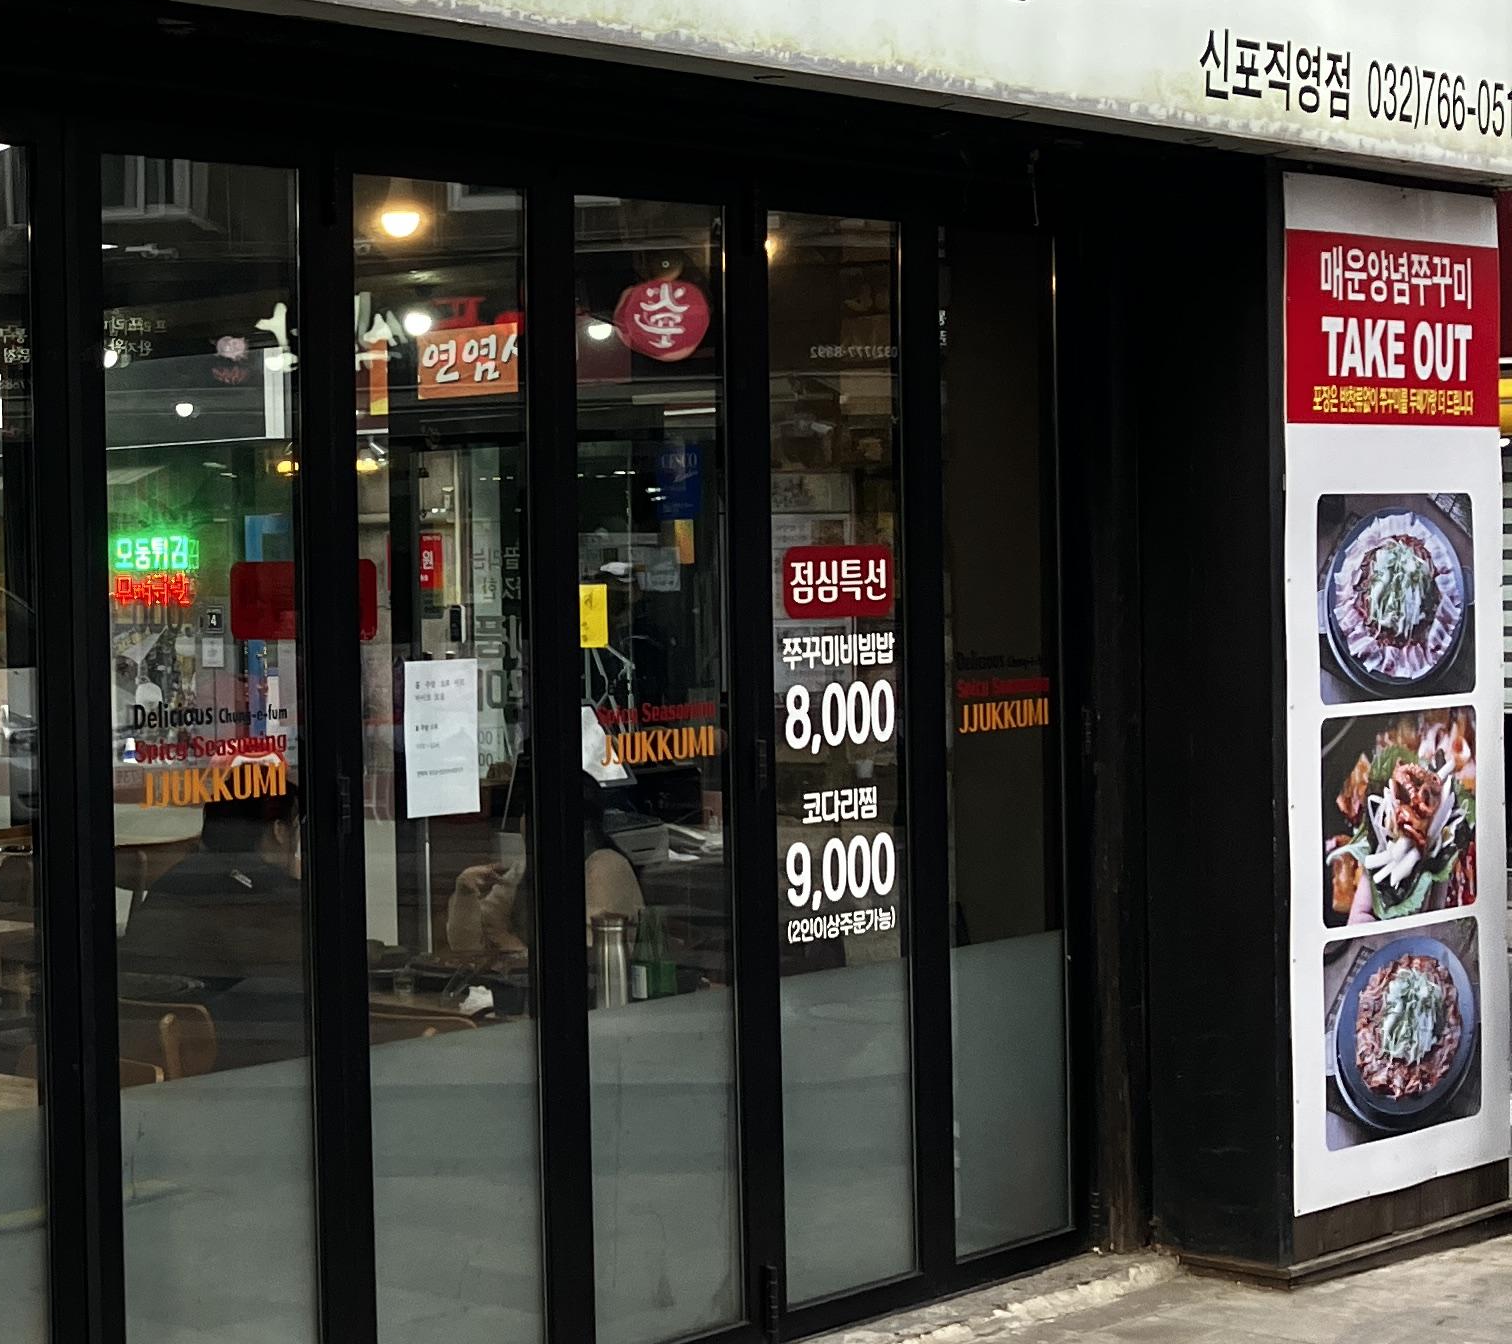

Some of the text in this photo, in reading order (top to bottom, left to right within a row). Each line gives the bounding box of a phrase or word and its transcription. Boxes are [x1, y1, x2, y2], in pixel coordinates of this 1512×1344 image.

[1199, 27, 1352, 121] 신포직영점
[1320, 245, 1473, 311] 매운양념쭈꾸미
[1321, 315, 1473, 382] TAKE OUT
[789, 558, 887, 604] 점심특선
[781, 631, 896, 671] 쭈꾸미비빔밥
[134, 703, 213, 731] Delicious
[785, 678, 896, 755] 8,000
[959, 697, 1049, 734] JJUKKUMI
[193, 731, 288, 758] Seasoning
[600, 725, 715, 767] JJUKKUMI
[141, 763, 287, 810] JJUKKUMI
[802, 785, 879, 825] 코다리찜
[786, 831, 896, 911] 9,000
[787, 905, 897, 944] (2인이상주문가능)
